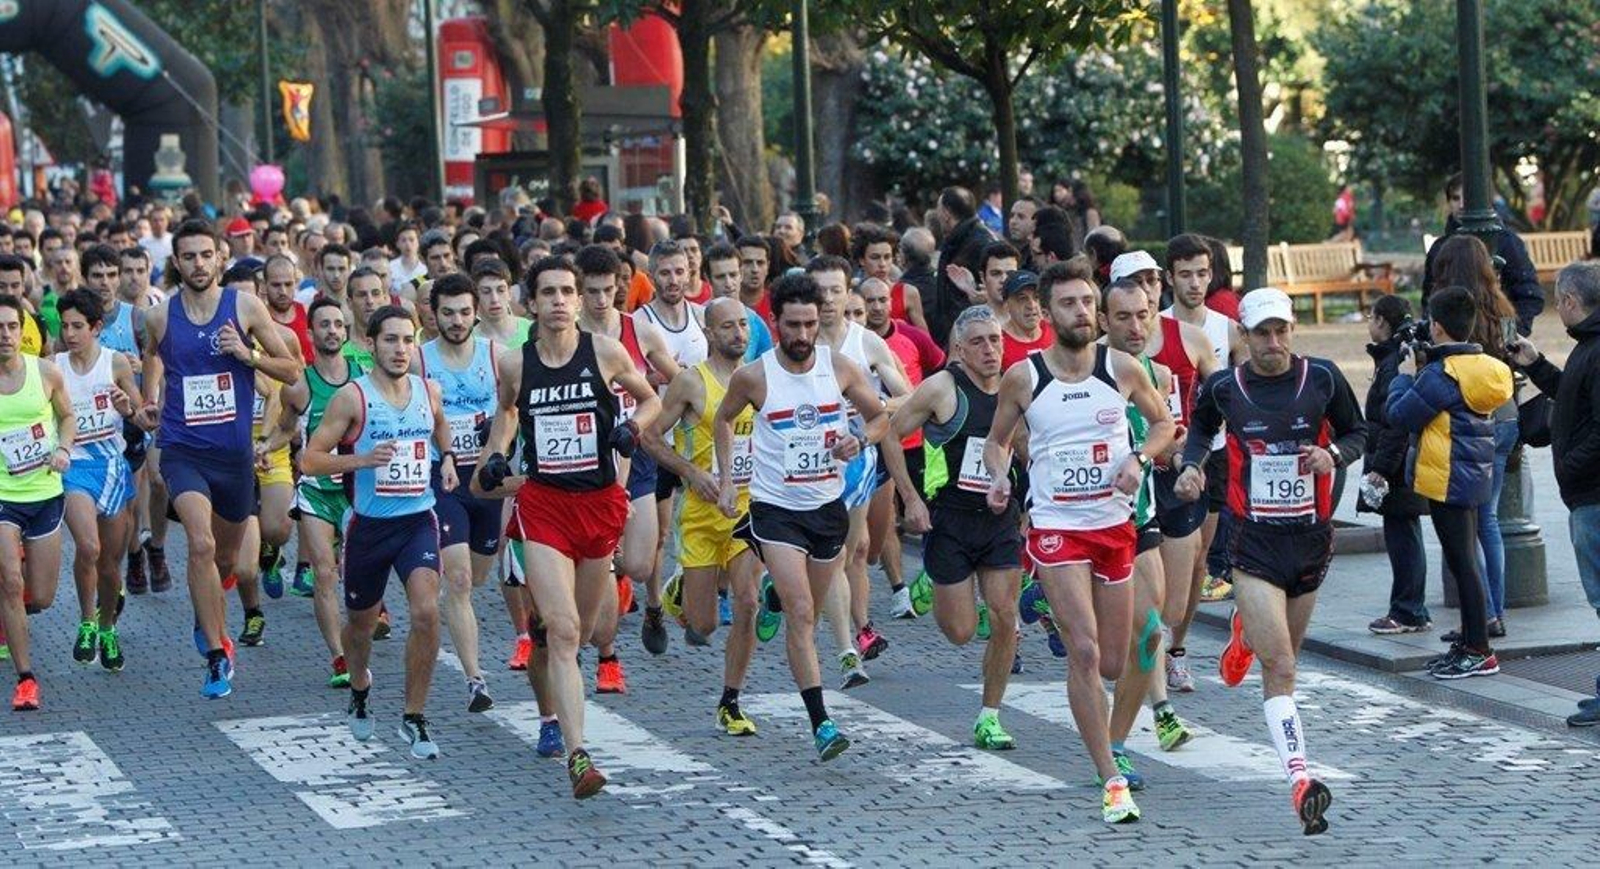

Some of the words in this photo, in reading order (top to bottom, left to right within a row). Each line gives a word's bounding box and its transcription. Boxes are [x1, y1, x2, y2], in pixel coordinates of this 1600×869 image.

[195, 393, 226, 409] 434
[529, 382, 594, 404] BIKILA
[77, 412, 106, 431] 217
[14, 441, 42, 462] 122
[547, 438, 583, 456] 271
[731, 456, 753, 472] 96
[798, 451, 831, 469] 314
[389, 463, 422, 480] 514
[1063, 466, 1102, 487] 209
[1267, 479, 1306, 498] 196
